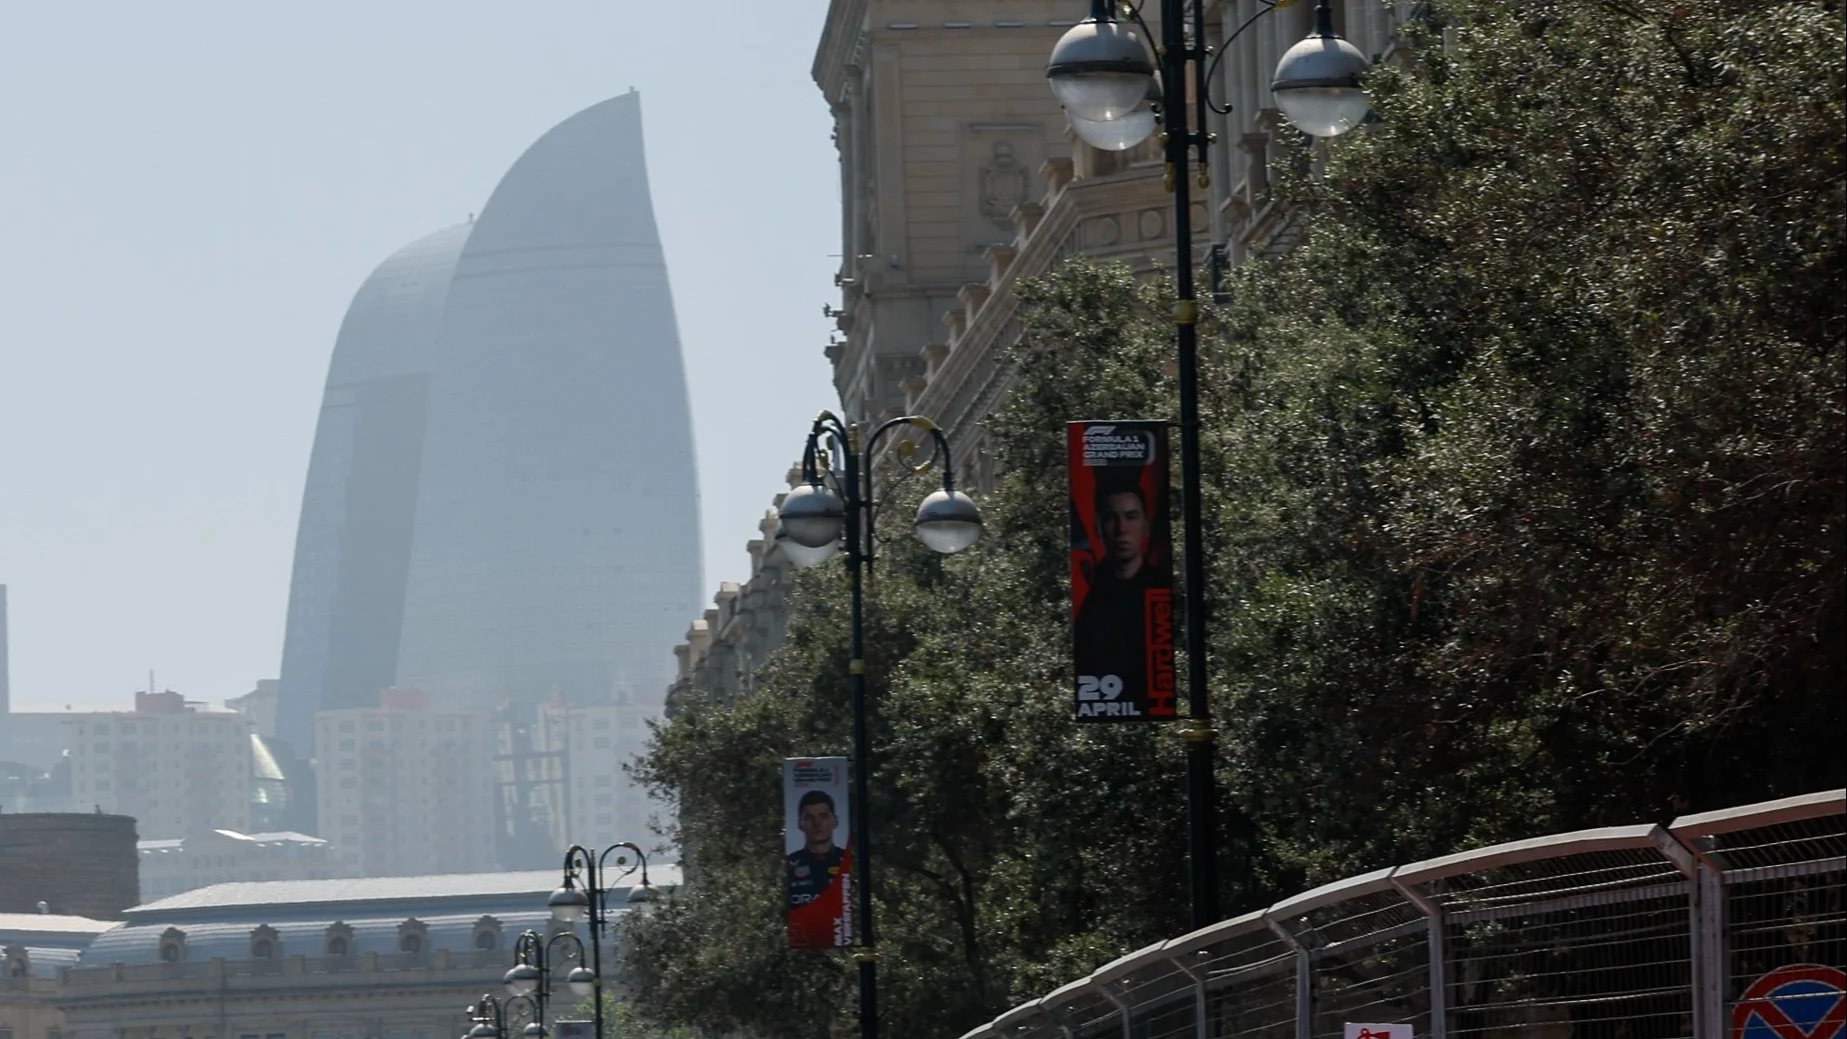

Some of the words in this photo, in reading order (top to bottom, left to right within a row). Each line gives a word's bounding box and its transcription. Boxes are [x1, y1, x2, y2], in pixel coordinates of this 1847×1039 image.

[1145, 588, 1175, 715] Hardwell
[1078, 675, 1123, 701] 29
[1078, 702, 1141, 717] APRIL
